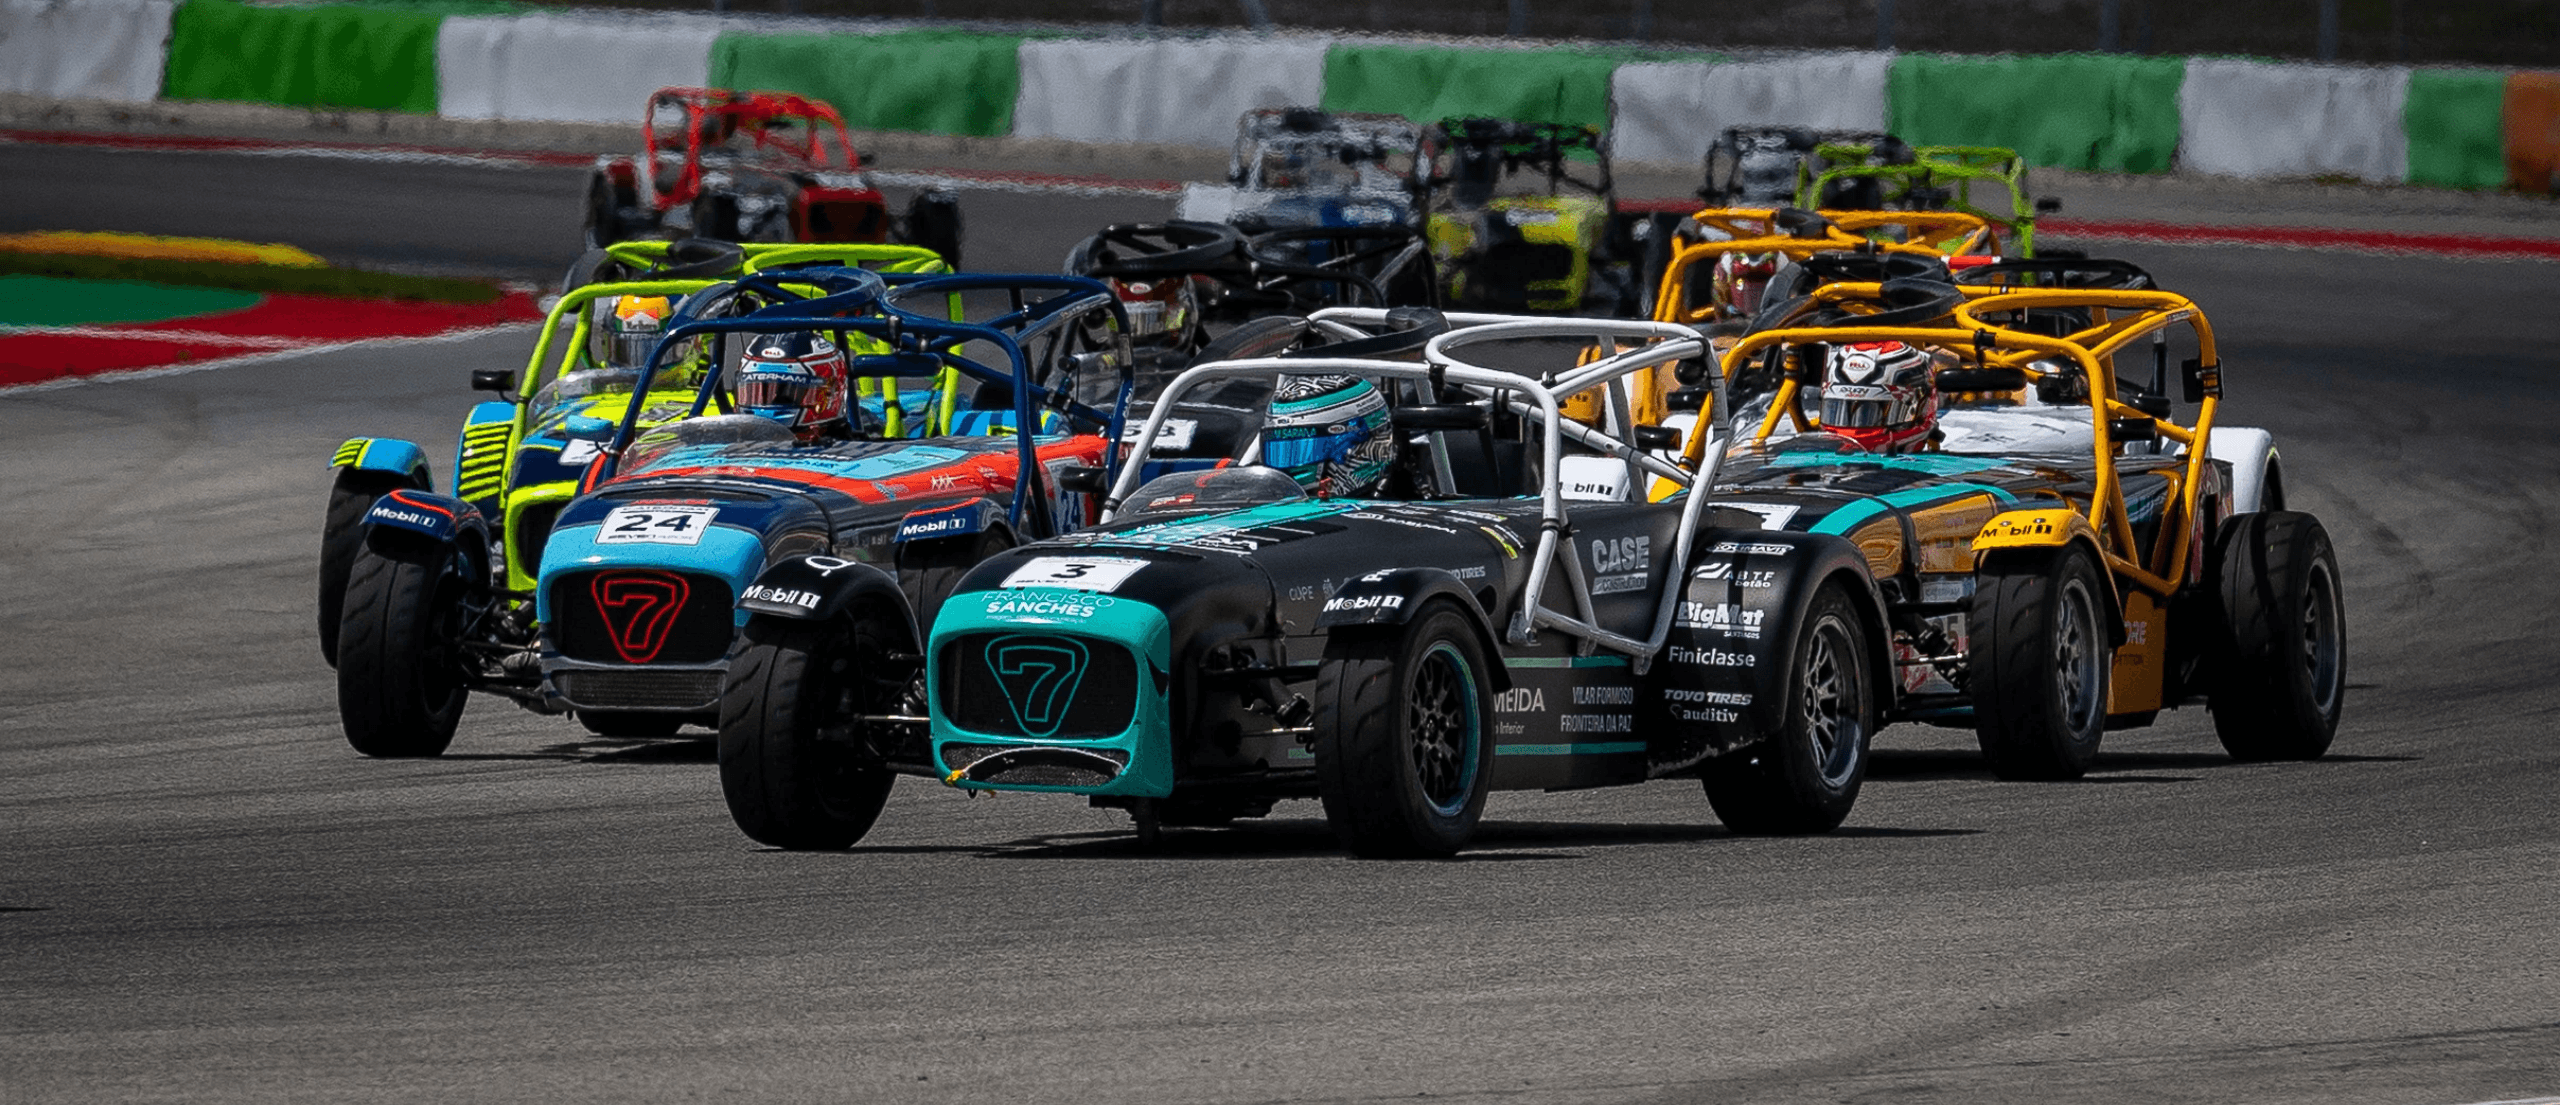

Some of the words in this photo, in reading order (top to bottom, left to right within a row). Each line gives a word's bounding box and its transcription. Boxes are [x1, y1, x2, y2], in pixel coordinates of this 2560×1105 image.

[372, 507, 419, 523] Mobil
[615, 514, 692, 532] 24
[902, 520, 948, 536] Mobil
[1592, 535, 1649, 573] CASE
[1051, 563, 1097, 579] 3
[1461, 564, 1486, 579] TIRES
[741, 584, 800, 604] Mobil
[797, 591, 822, 609] 1
[981, 590, 1115, 608] FRANCISCO
[1323, 595, 1383, 612] Mobil
[1381, 594, 1405, 610] 1
[604, 579, 677, 649] 7
[986, 600, 1096, 618] SANCHES
[1678, 601, 1764, 628] BigMat
[1669, 646, 1756, 667] Finiclasse
[999, 645, 1075, 723] 7
[1572, 686, 1596, 705] VILAR
[1664, 689, 1705, 702] TOYO
[1706, 691, 1753, 706] TIRES
[1683, 707, 1738, 722] auditiv
